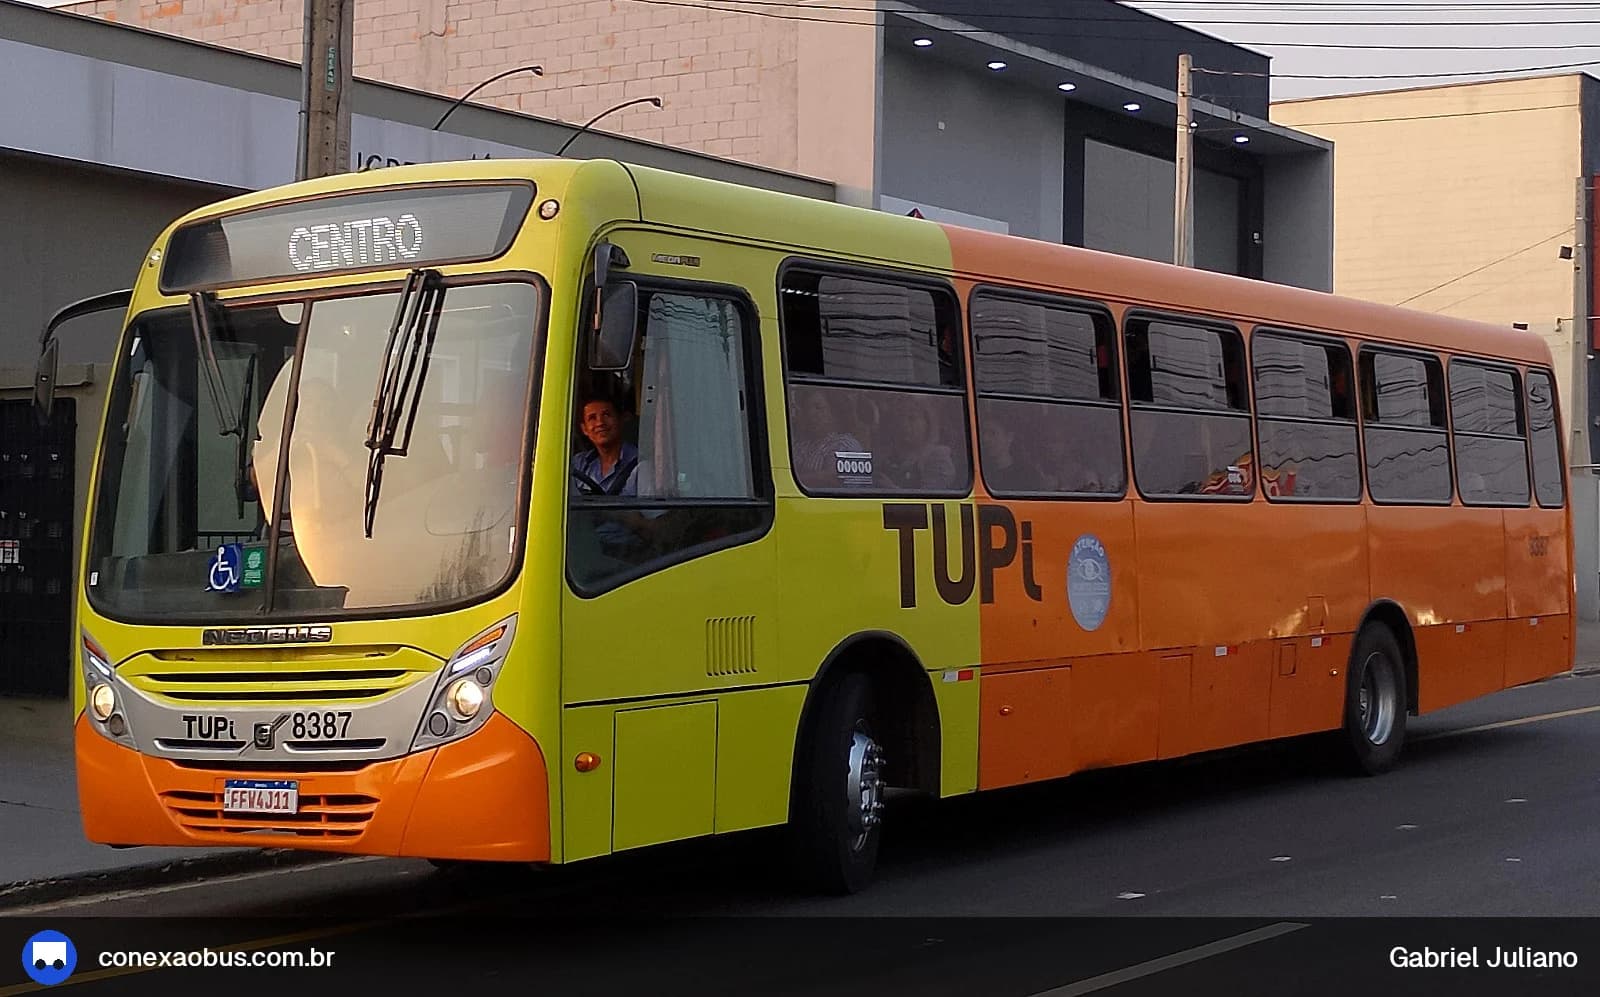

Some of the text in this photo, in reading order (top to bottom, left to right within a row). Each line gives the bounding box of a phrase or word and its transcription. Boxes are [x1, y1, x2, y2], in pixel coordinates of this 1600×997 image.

[288, 214, 423, 271] CENTRO
[837, 460, 872, 473] 00000
[202, 626, 332, 645] NEOBUS
[292, 711, 352, 739] 8387
[230, 790, 290, 810] FFW4J11
